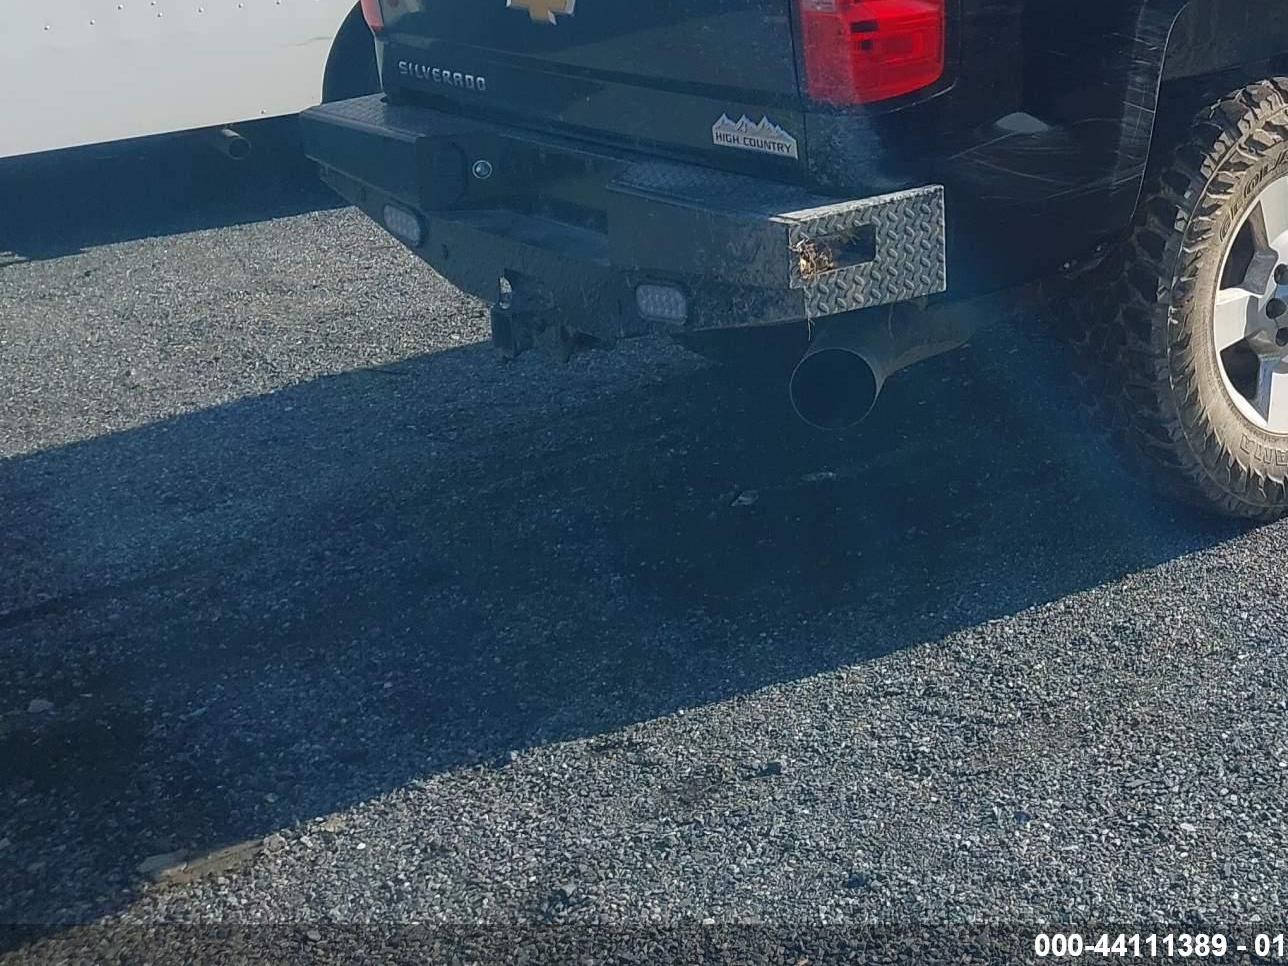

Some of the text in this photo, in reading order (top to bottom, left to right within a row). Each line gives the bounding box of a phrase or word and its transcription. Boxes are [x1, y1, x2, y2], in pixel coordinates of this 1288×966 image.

[397, 60, 487, 91] SILVERADO
[714, 131, 793, 154] HIGH COUNTRY
